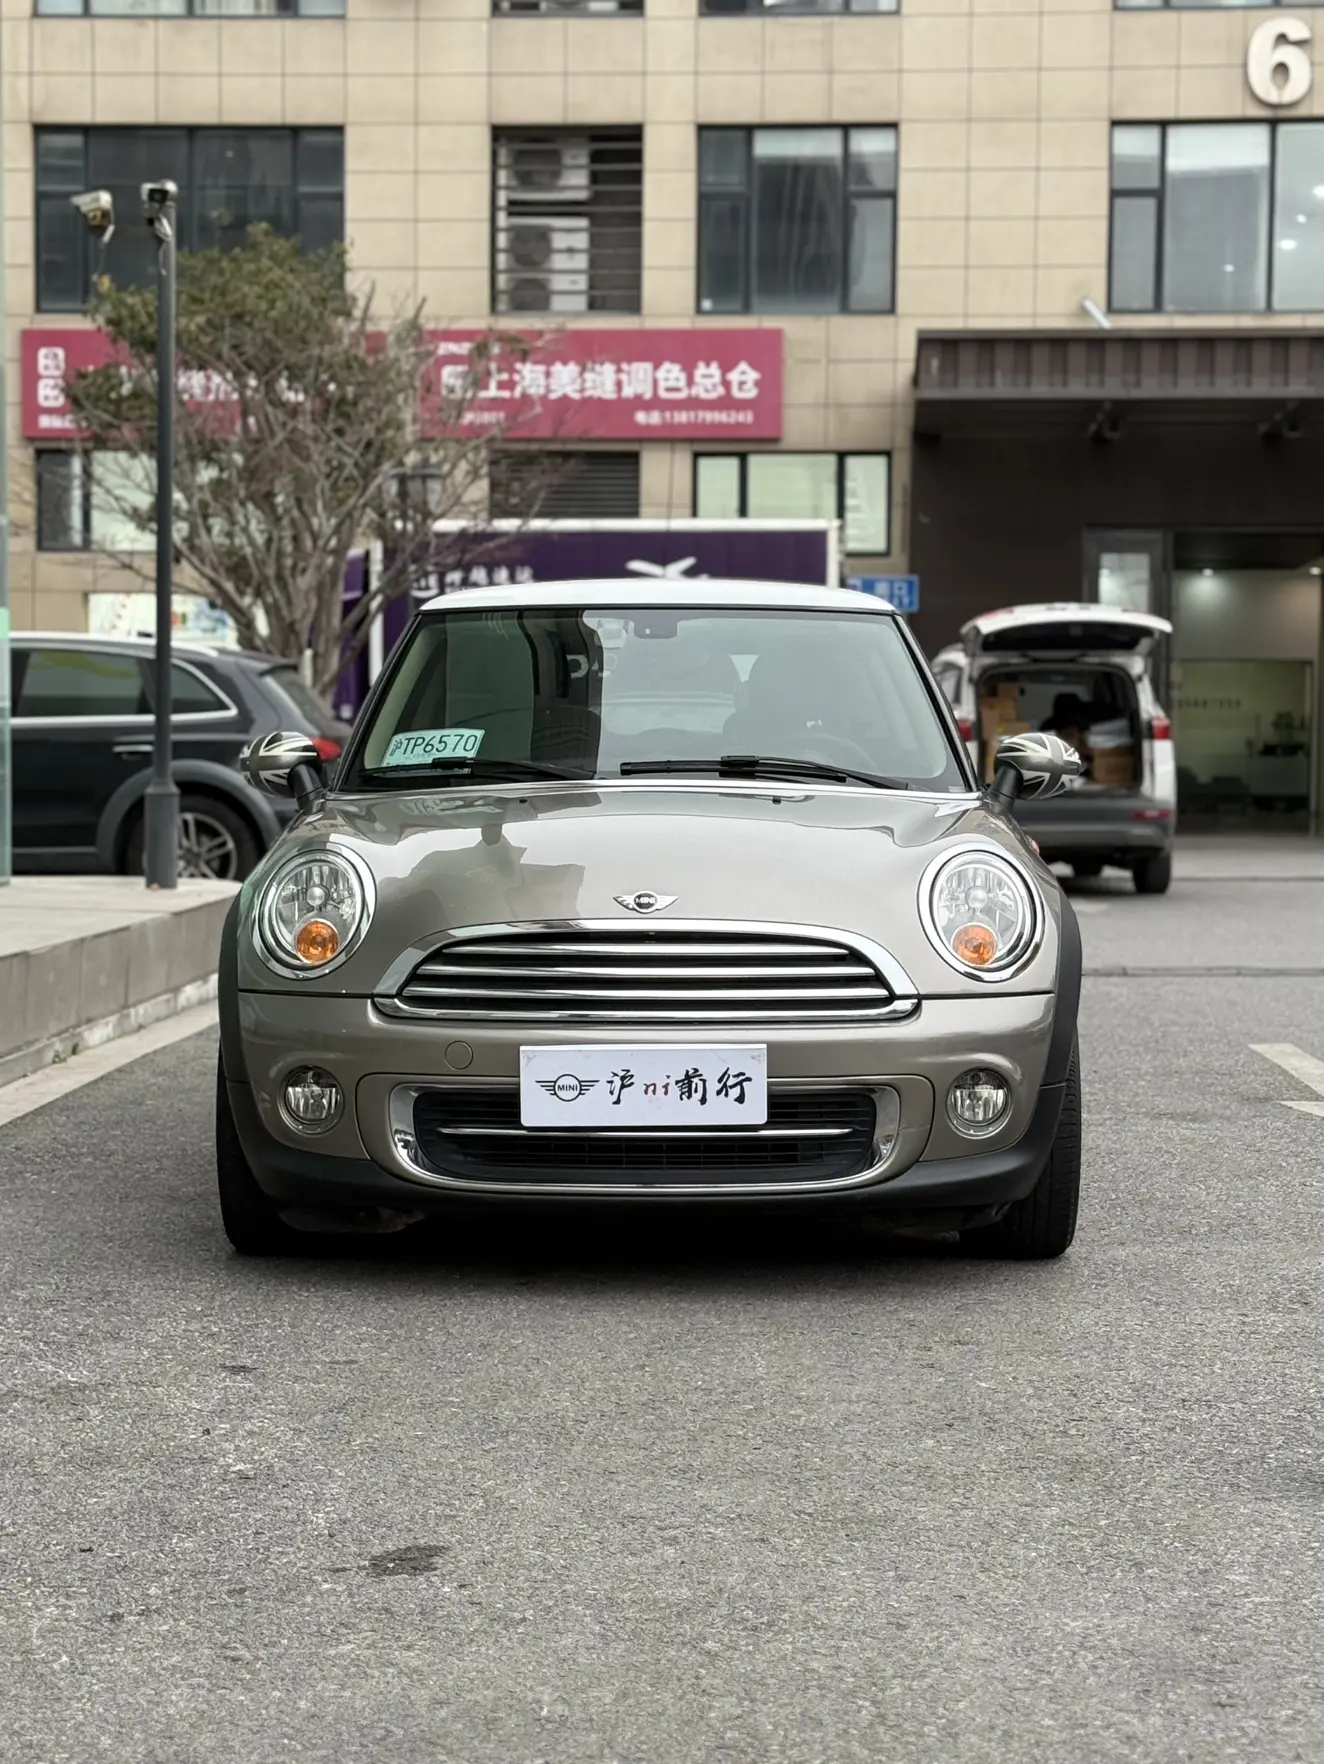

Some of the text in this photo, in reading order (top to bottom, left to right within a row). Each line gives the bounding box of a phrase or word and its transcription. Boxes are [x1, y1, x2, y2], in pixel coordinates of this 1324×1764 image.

[1247, 16, 1312, 105] 6
[389, 734, 479, 757] 沪TP6570
[557, 1083, 579, 1092] MINI
